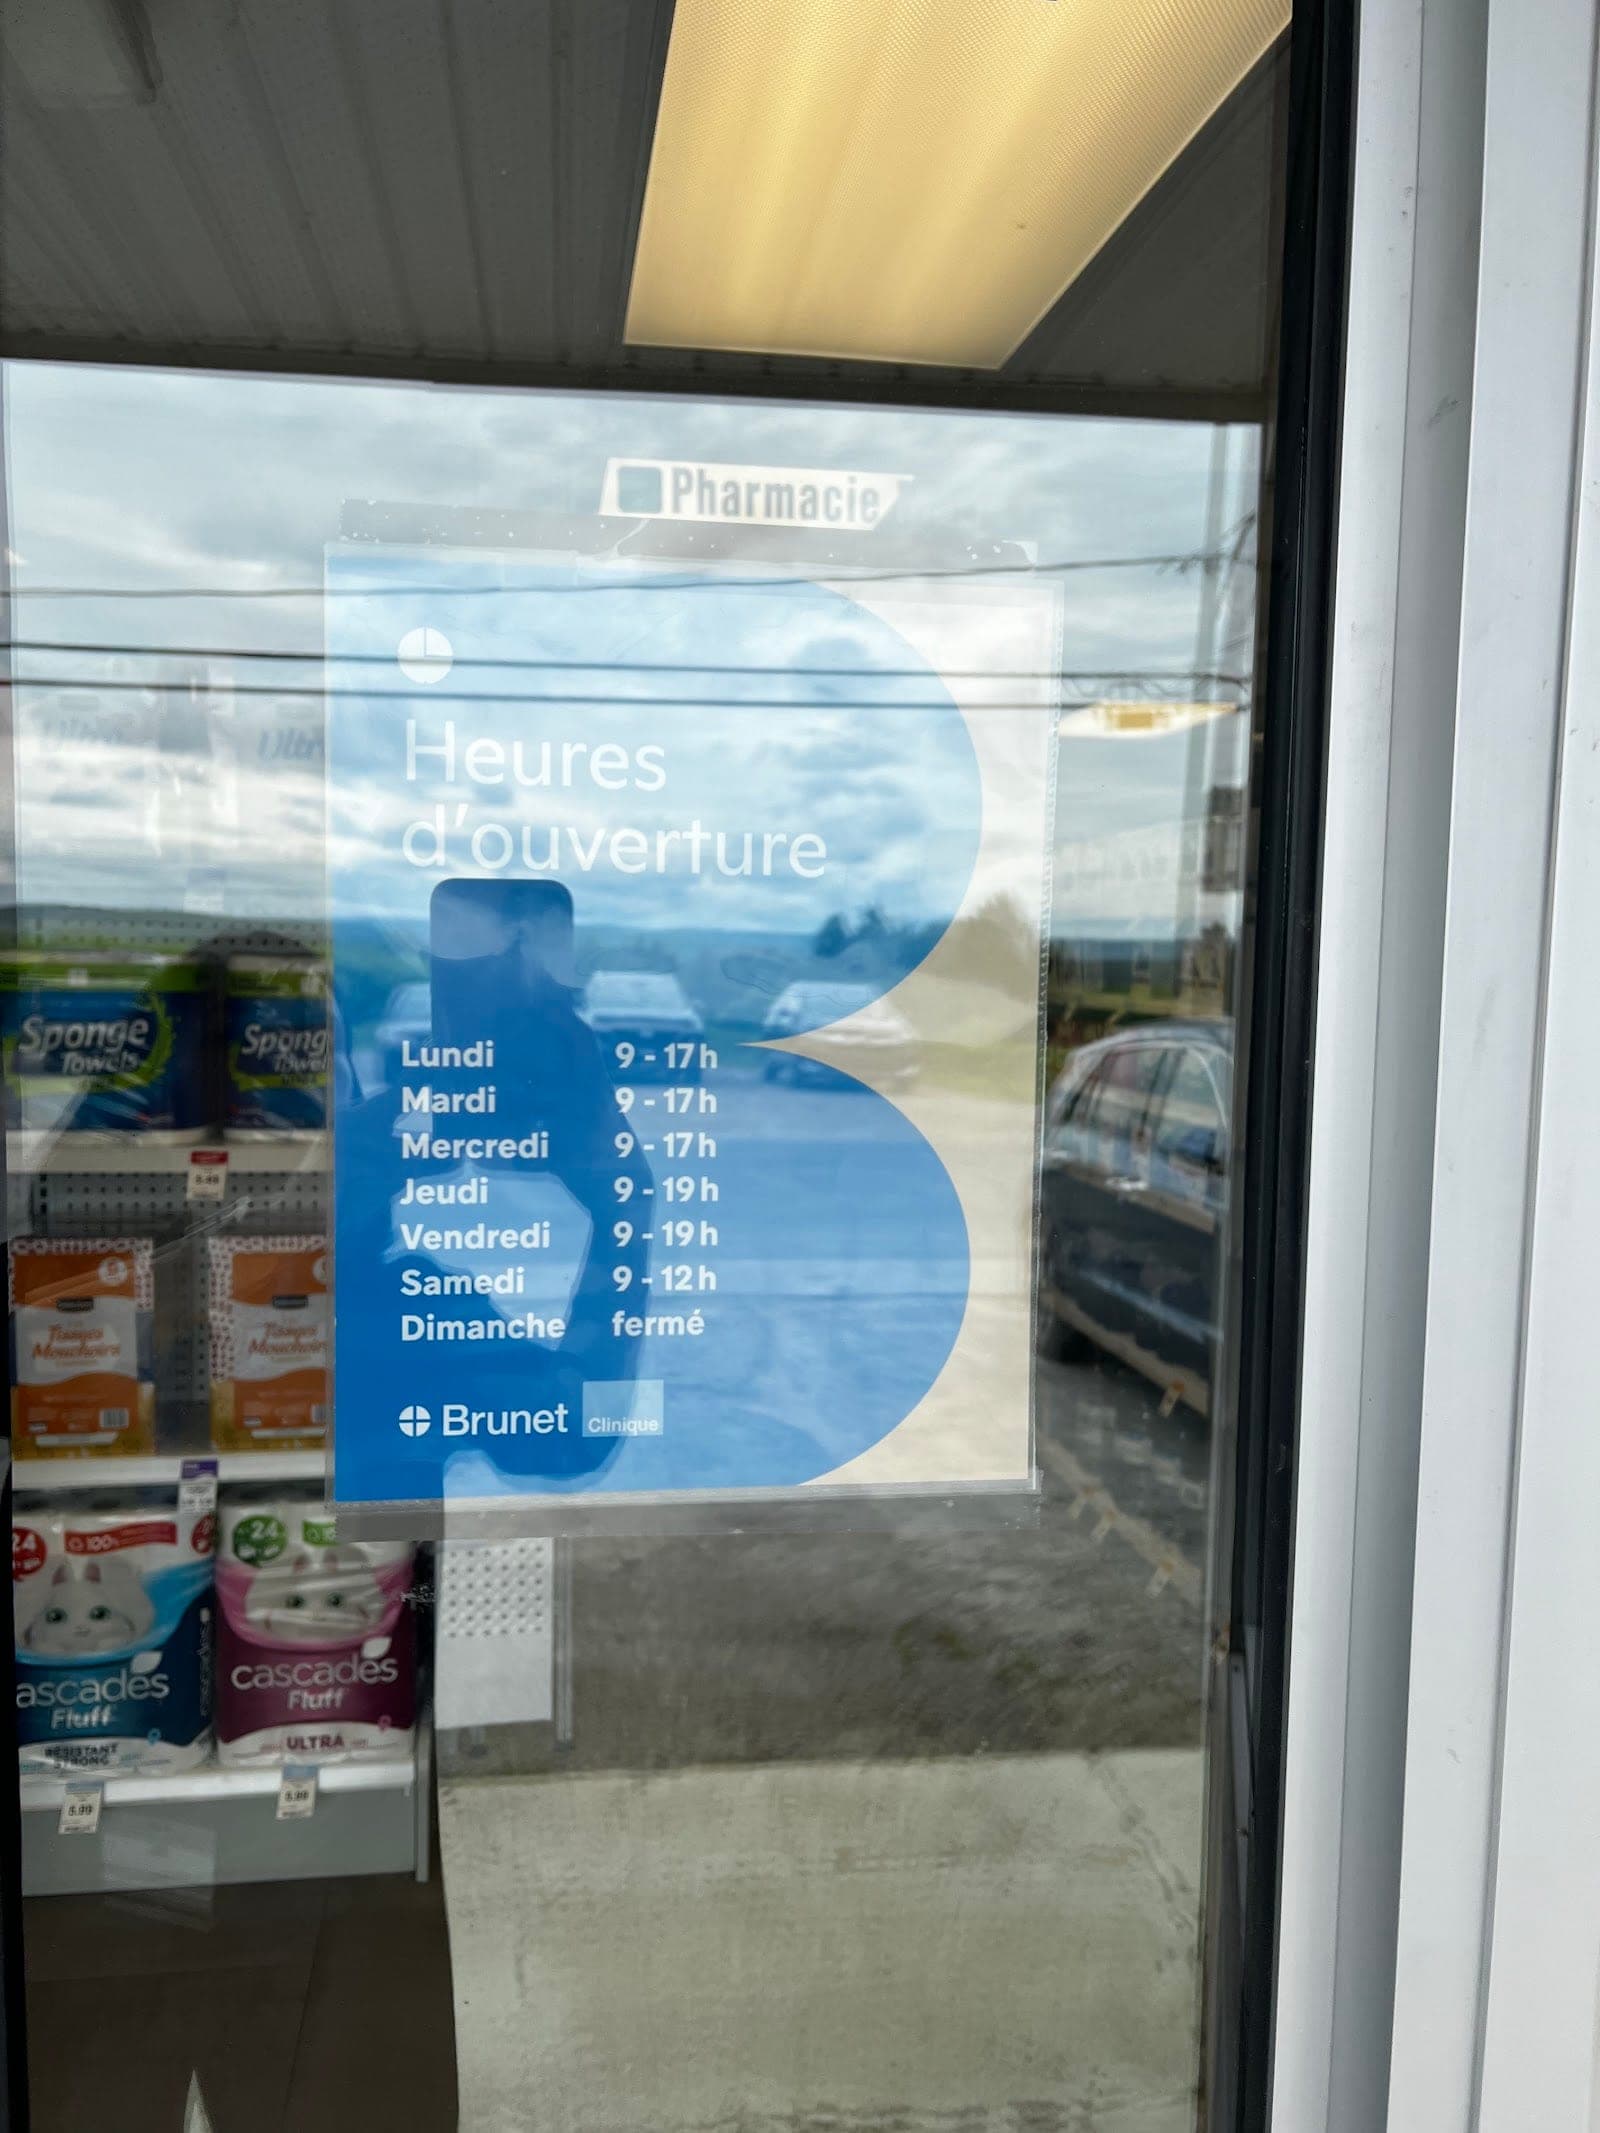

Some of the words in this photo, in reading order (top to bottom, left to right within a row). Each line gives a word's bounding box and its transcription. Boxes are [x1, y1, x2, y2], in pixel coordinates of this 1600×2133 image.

[671, 466, 881, 523] Pharmacie
[404, 719, 667, 791] Heures
[18, 1014, 149, 1060] Sponge
[242, 1022, 327, 1058] Spong
[272, 1052, 327, 1073] Towel
[402, 1040, 494, 1068] Lundi
[615, 1042, 635, 1068] 9
[402, 1086, 496, 1113] Mardi
[615, 1087, 635, 1113] 9
[402, 1131, 549, 1158] Mercredi
[614, 1132, 634, 1158] 9
[399, 1177, 489, 1204] Jeudi
[613, 1177, 634, 1202] 9
[400, 1221, 550, 1250] Vendredi
[613, 1221, 634, 1247] 9
[400, 1267, 525, 1296] Samedi
[613, 1266, 633, 1291] 9
[401, 1313, 566, 1341] Dimanche
[612, 1309, 705, 1337] fermé
[442, 1403, 569, 1436] Brunet
[587, 1416, 660, 1437] Clinique
[251, 1521, 280, 1541] 24
[231, 1652, 399, 1691] cascades
[16, 1668, 169, 1708] ascades
[288, 1690, 346, 1711] Fluff
[51, 1704, 112, 1730] Fluff
[286, 1735, 346, 1752] ULTRA
